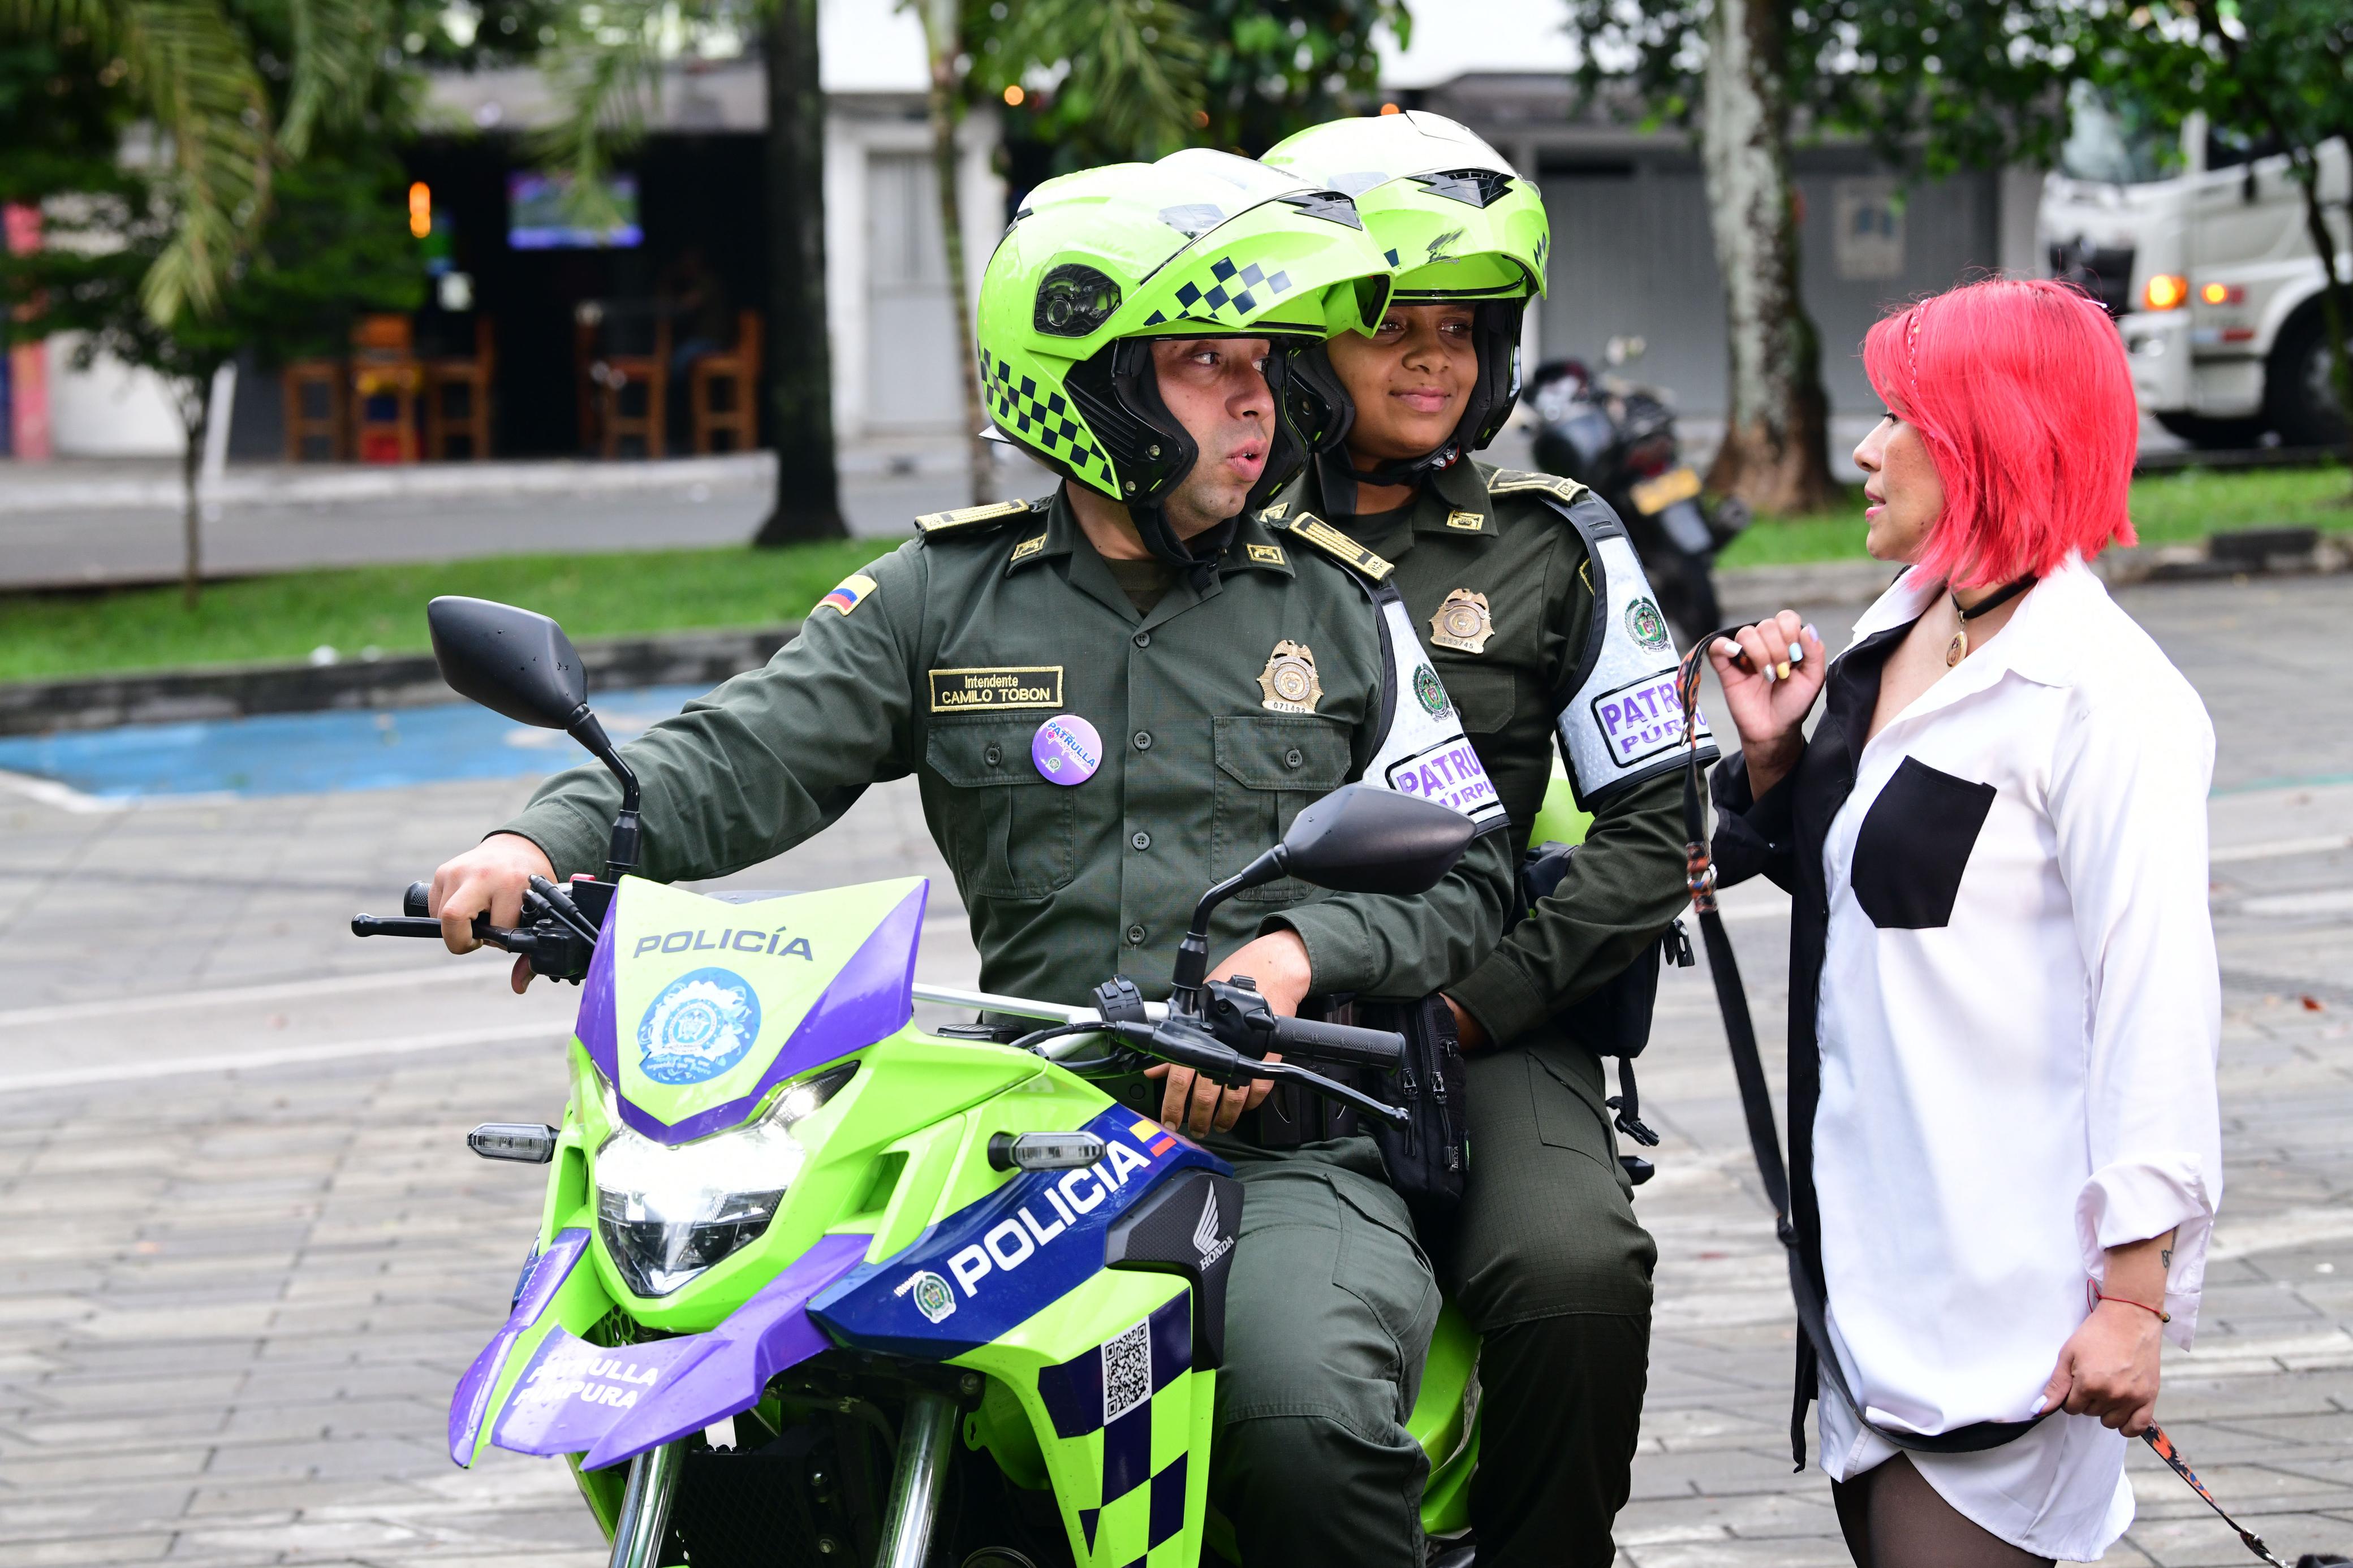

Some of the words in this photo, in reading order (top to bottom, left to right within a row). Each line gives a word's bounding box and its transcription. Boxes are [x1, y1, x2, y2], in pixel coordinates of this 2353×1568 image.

[1442, 637, 1474, 649] 153745
[942, 689, 993, 705] CAMILO
[998, 688, 1050, 702] TOBON
[964, 674, 1019, 689] Intendente
[1273, 702, 1306, 713] 071432
[1601, 680, 1683, 736] PATR
[1047, 722, 1096, 768] PATRULLA
[1621, 712, 1706, 754] PÚRU
[1396, 744, 1486, 798] PATRU
[1438, 779, 1495, 809] ÚRPU
[632, 926, 813, 962] POLICÍA
[946, 1139, 1152, 1298] POLICIA
[1199, 1235, 1234, 1272] HONDA
[526, 1356, 659, 1387] PRULLA
